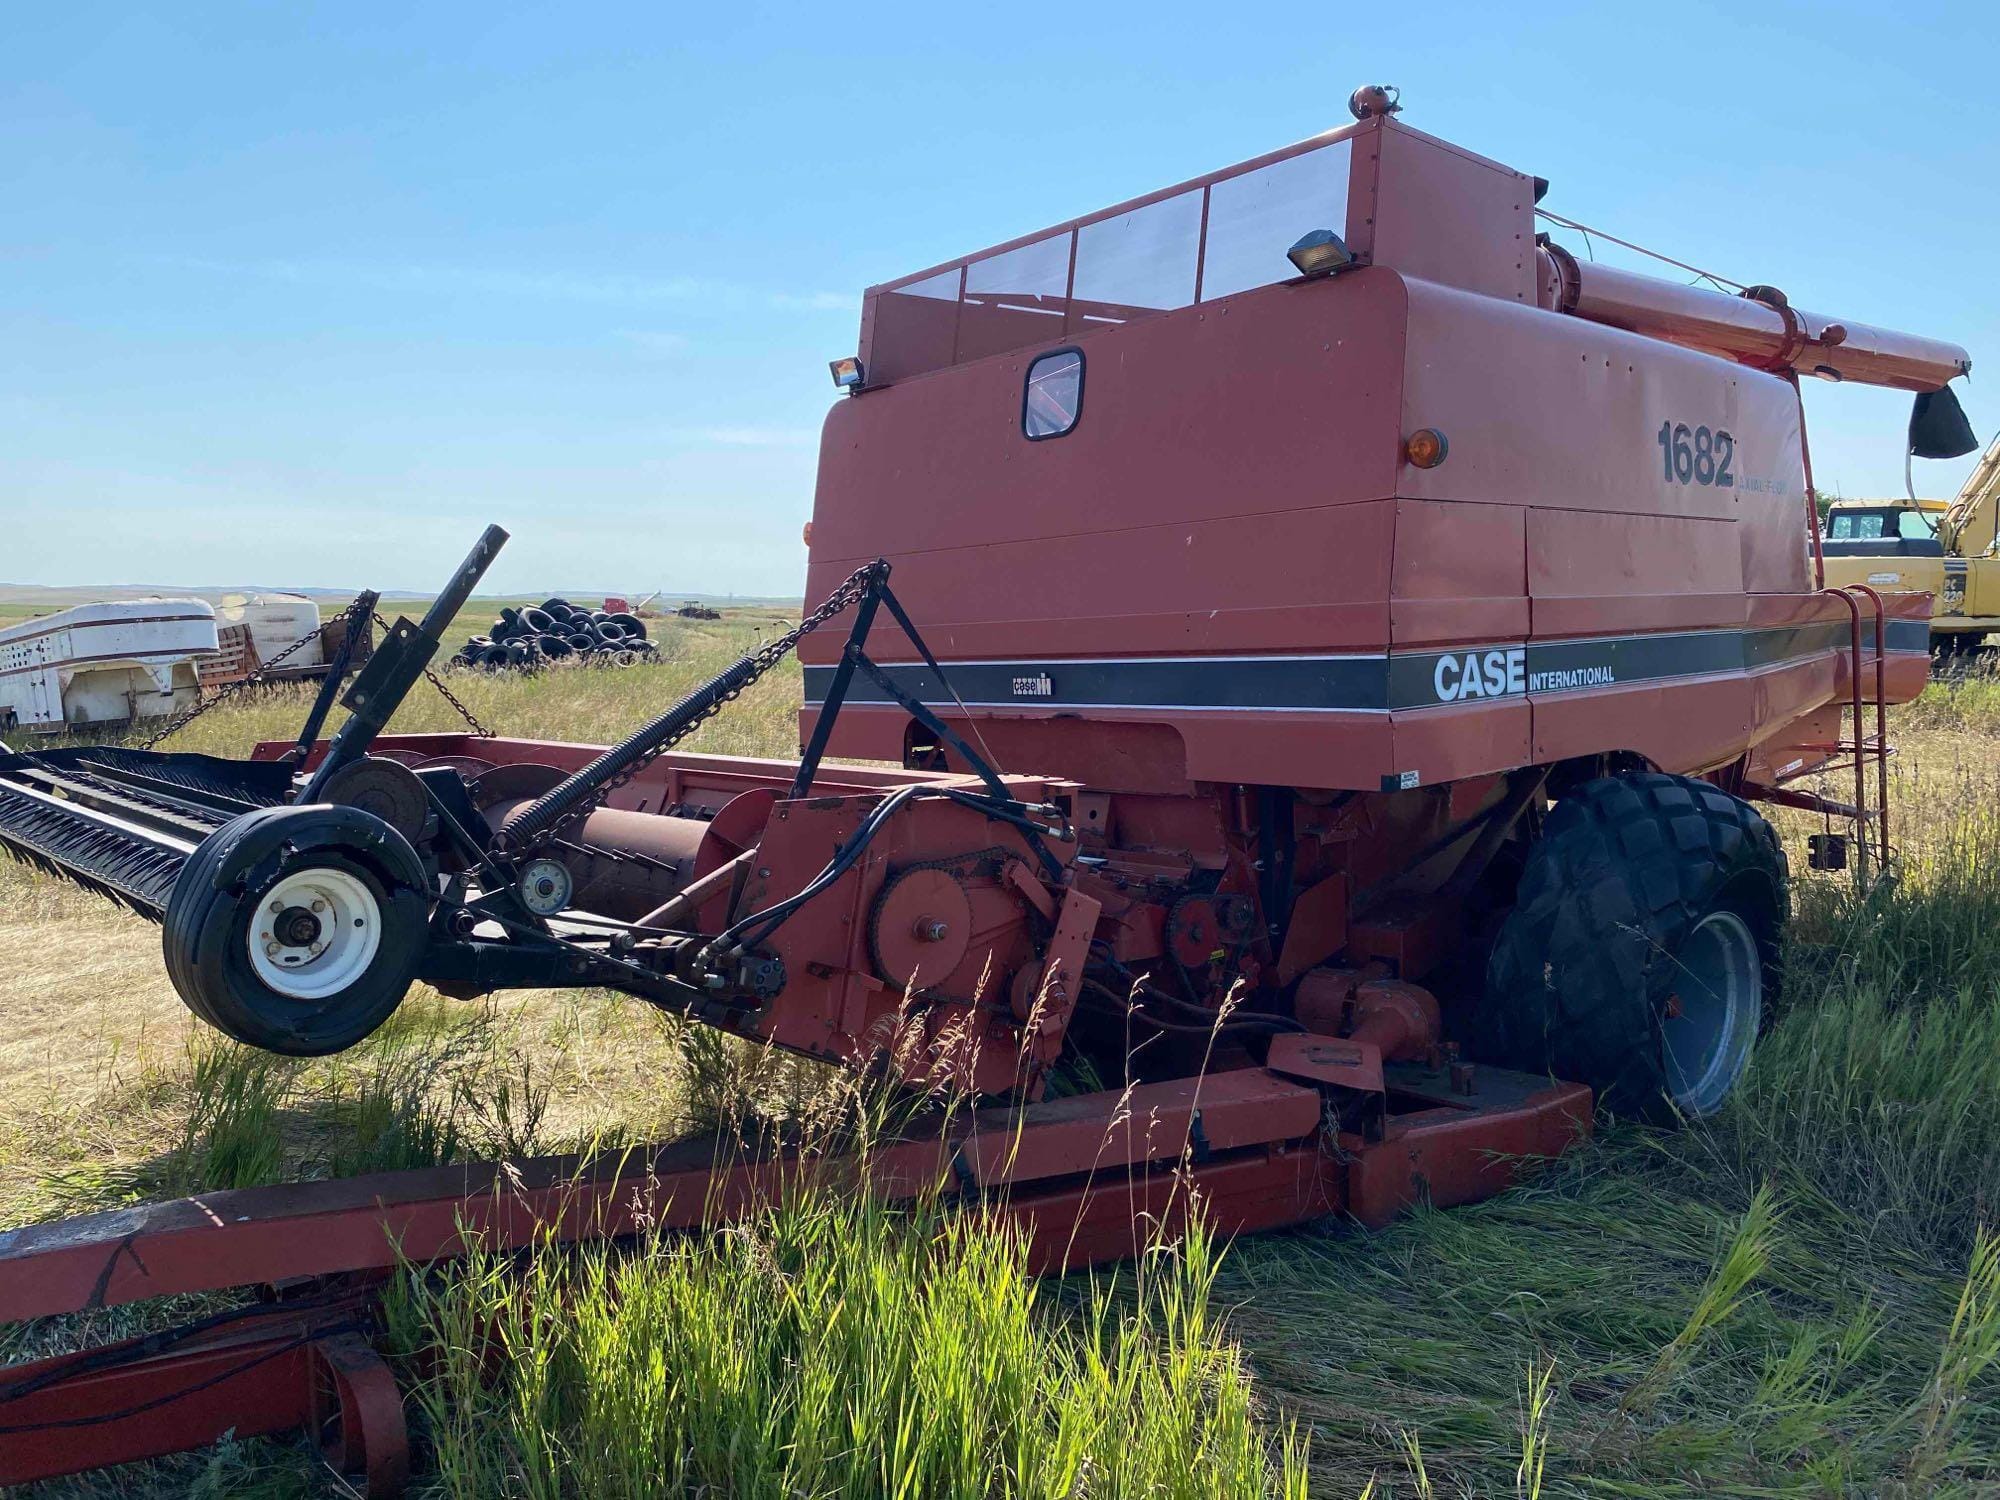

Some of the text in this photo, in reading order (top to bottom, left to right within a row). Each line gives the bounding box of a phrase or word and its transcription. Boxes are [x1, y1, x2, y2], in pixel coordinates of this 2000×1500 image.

[1658, 420, 1734, 487] 1682
[1434, 649, 1615, 701] CASE INTERNATIONAL
